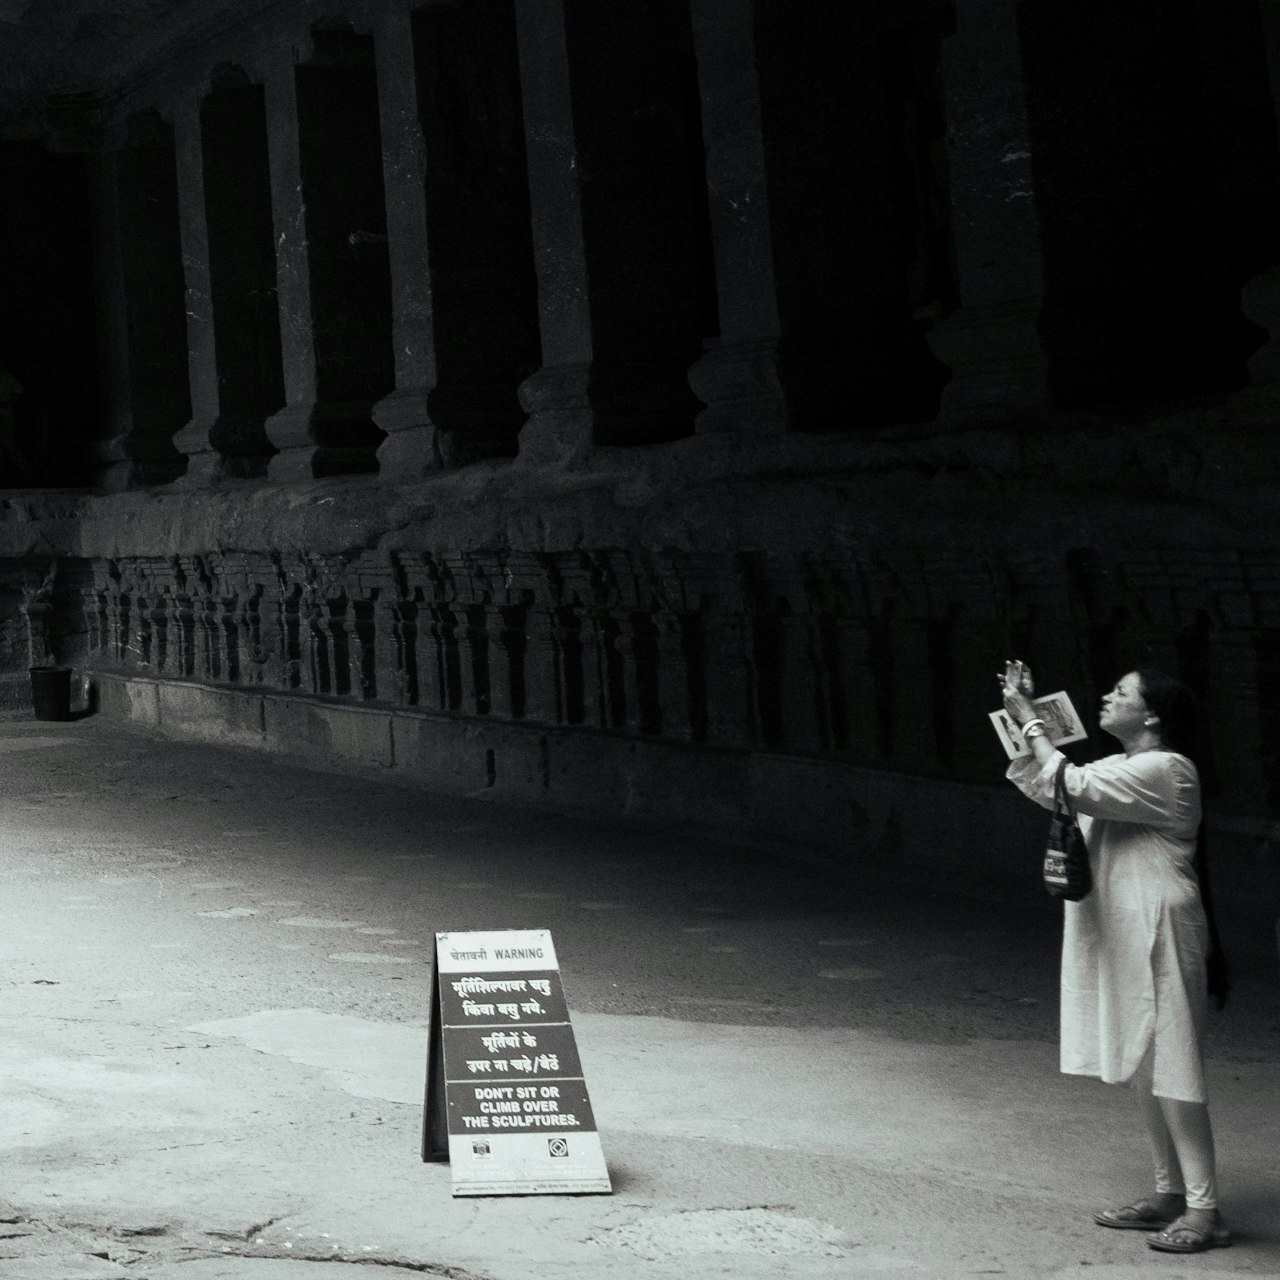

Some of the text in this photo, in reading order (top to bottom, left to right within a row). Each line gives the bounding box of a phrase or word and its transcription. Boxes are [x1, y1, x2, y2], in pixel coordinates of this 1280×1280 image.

[450, 947, 487, 960] चेतावनी
[495, 948, 544, 960] WARNING
[462, 1000, 495, 1016] किंवा
[521, 998, 546, 1014] नये.
[481, 1031, 537, 1053] मूर्तियों के
[466, 1060, 492, 1073] उपर
[492, 1060, 509, 1072] ना
[474, 1086, 560, 1100] DON'T SIT OR
[480, 1100, 559, 1113] CLIMB OVER
[462, 1114, 581, 1128] THE SCULPTURES.
